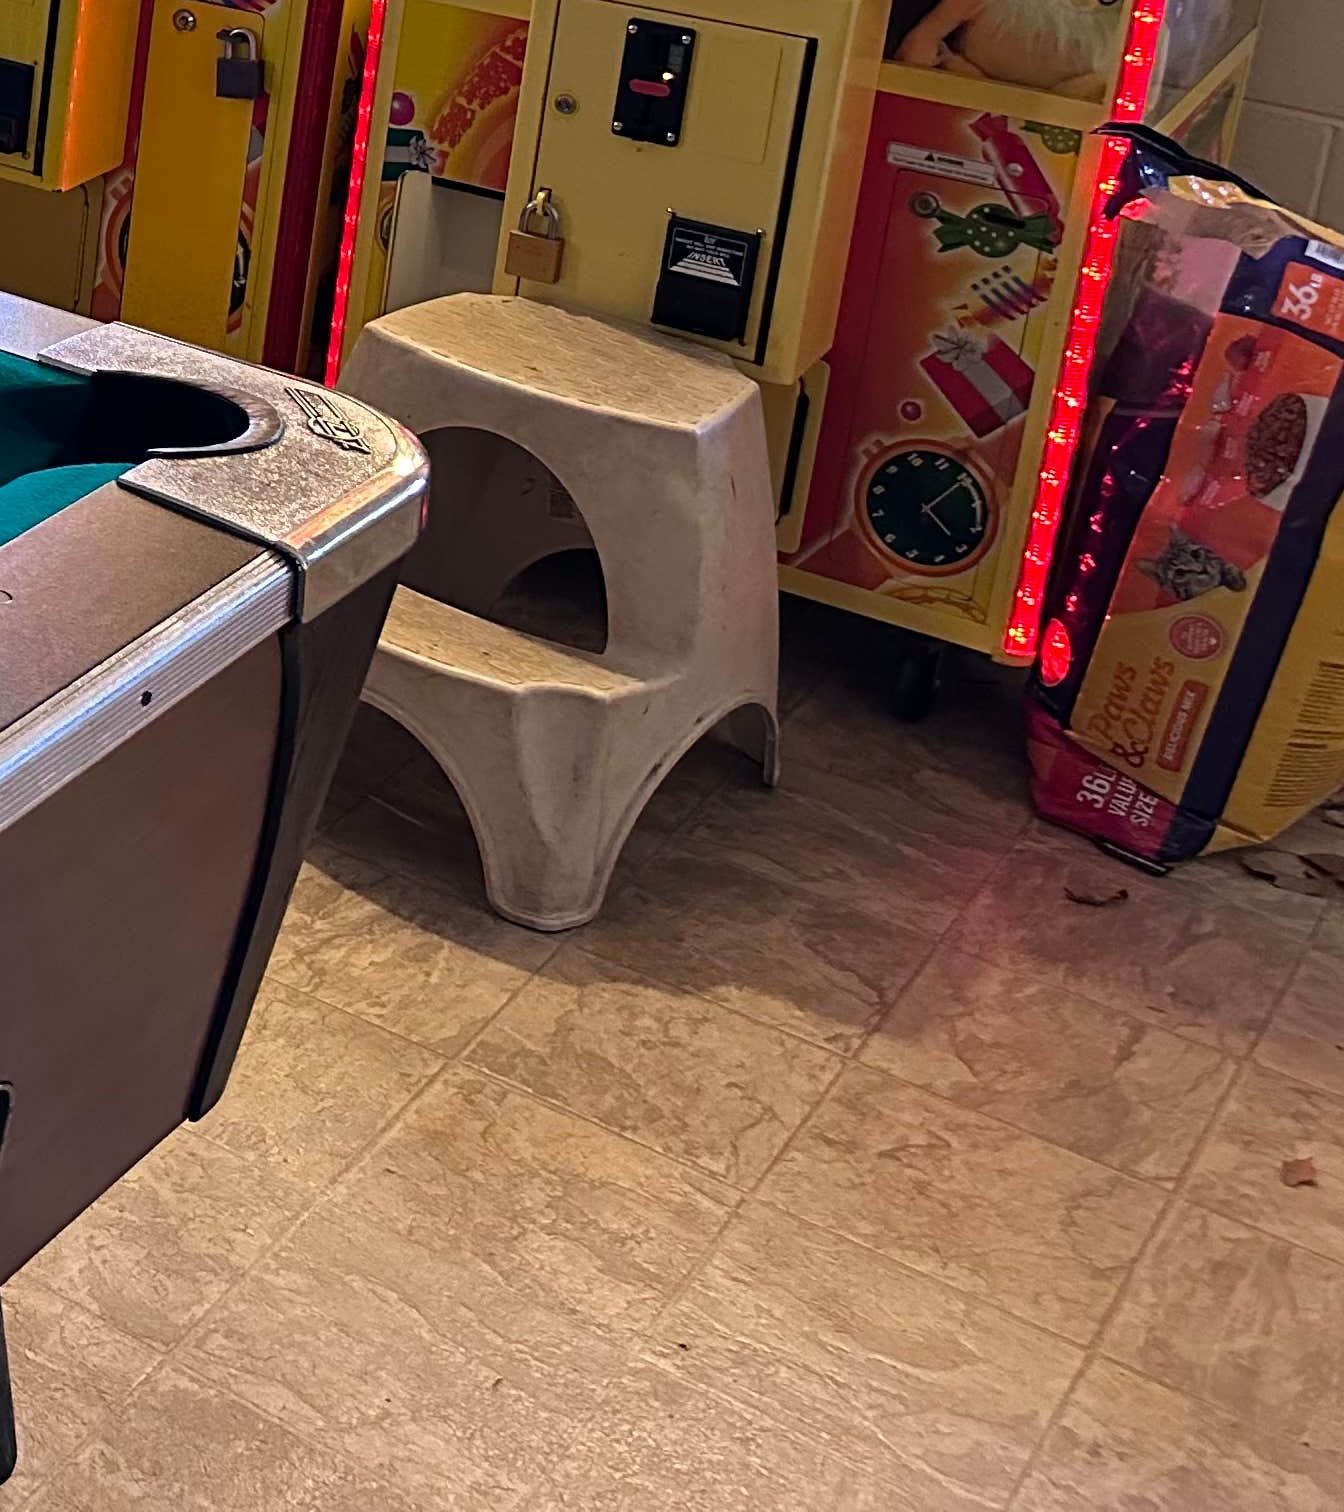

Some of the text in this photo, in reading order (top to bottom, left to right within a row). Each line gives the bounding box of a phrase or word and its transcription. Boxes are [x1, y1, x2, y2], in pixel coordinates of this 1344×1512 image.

[1087, 660, 1137, 740] Paws
[1123, 655, 1176, 742] Claws
[1130, 791, 1159, 828] SIZE
